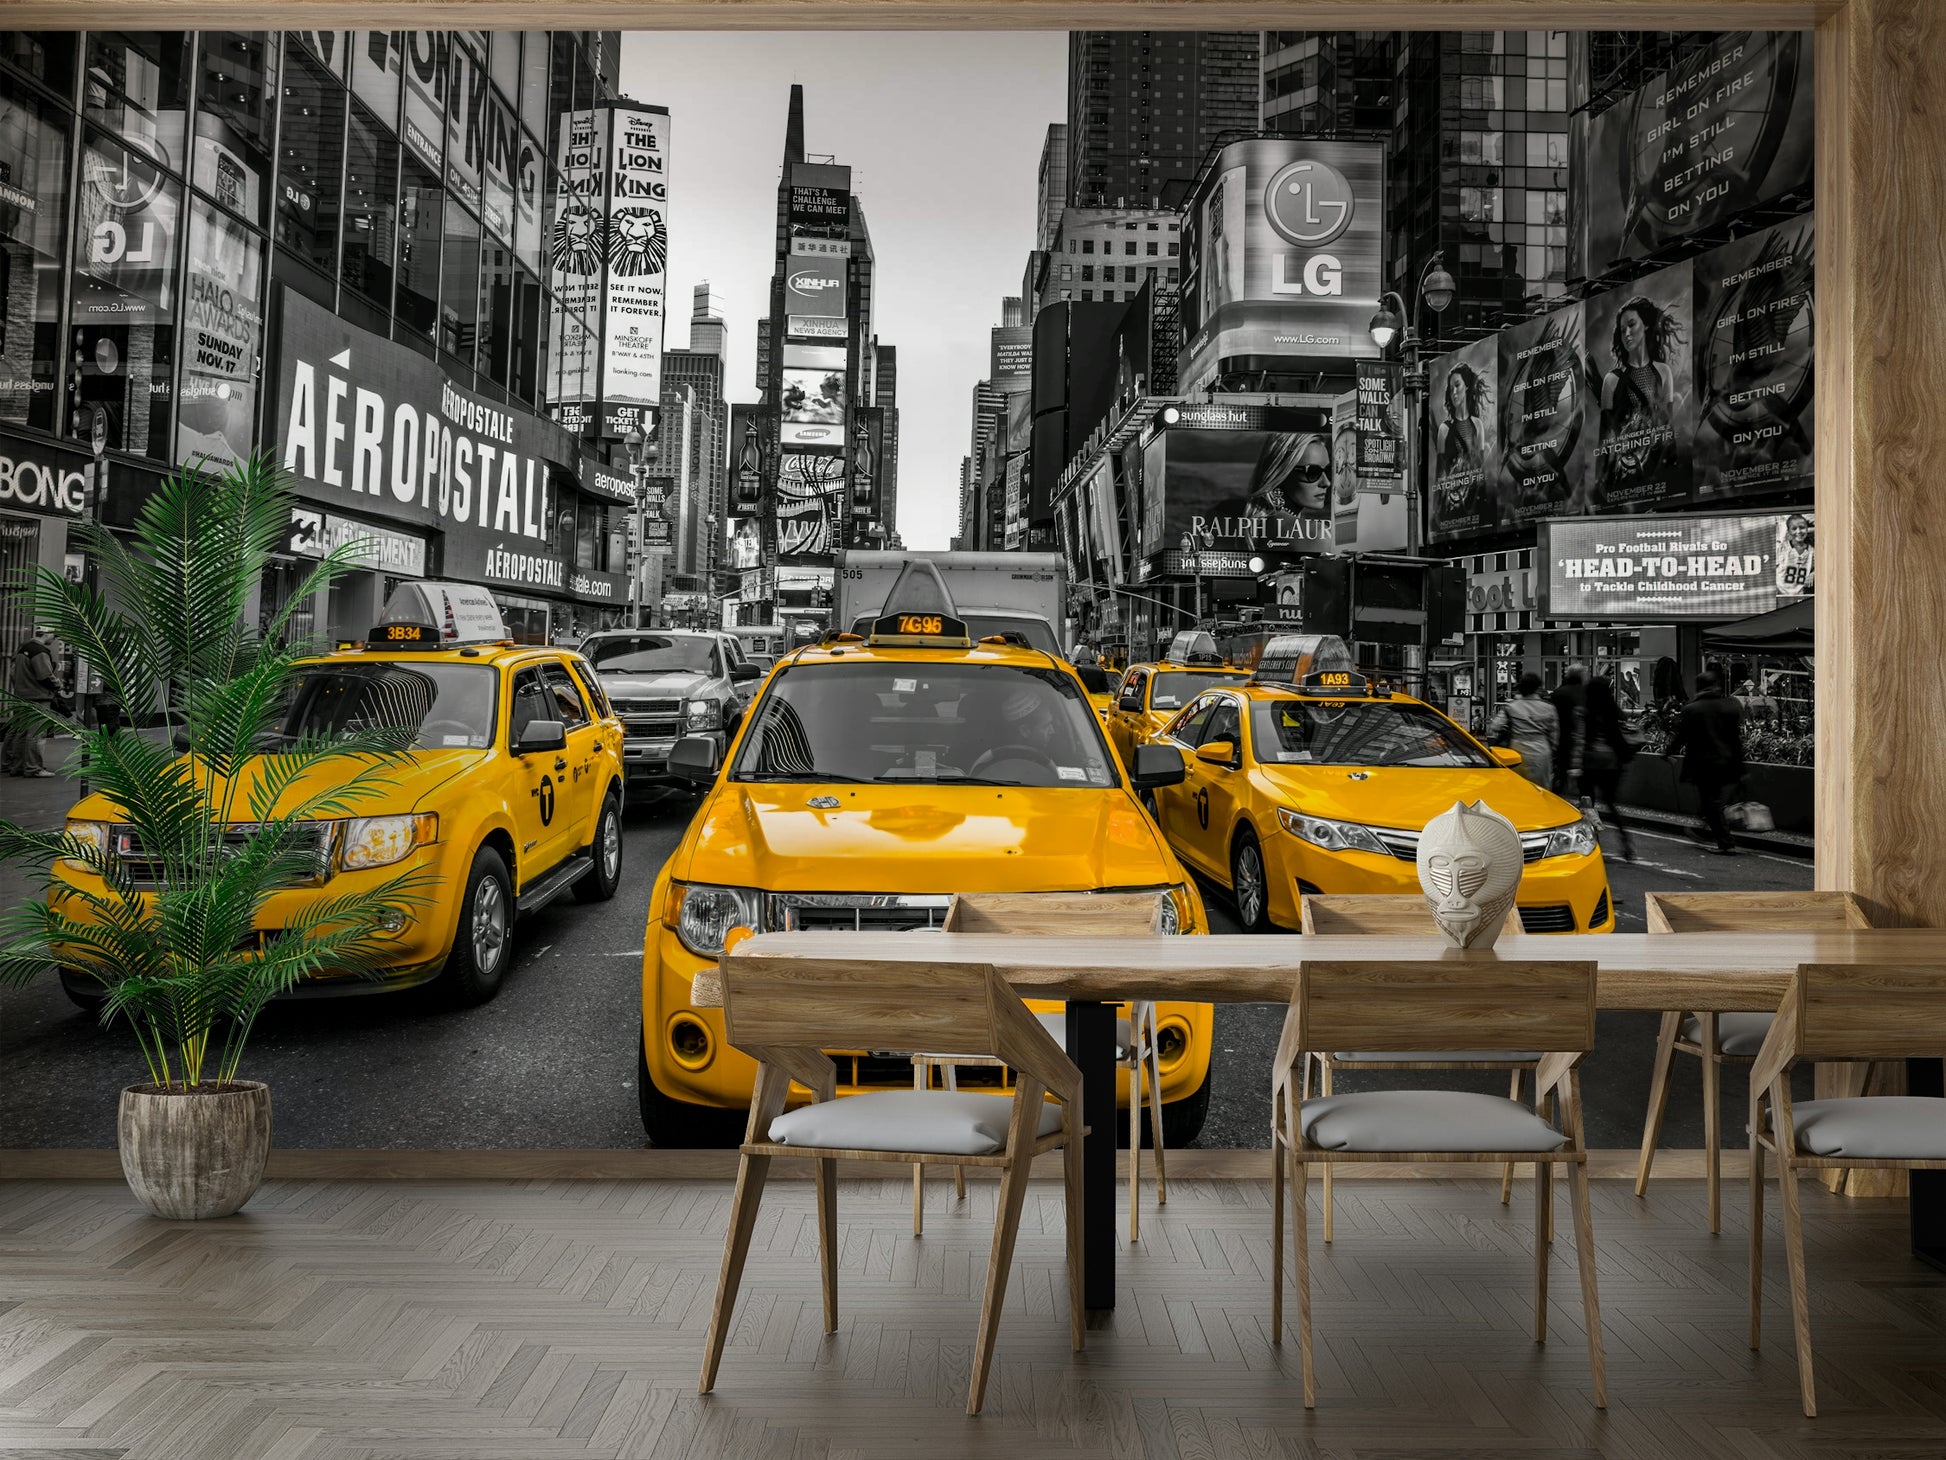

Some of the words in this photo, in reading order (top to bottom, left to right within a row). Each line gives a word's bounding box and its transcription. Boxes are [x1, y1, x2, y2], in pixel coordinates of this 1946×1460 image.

[1655, 45, 1743, 109] REMEMBER
[1647, 118, 1681, 143] GIRL
[1687, 97, 1710, 120] ON
[1716, 71, 1753, 103] FIRE
[627, 116, 653, 129] Disney
[407, 123, 441, 168] ENTRANCE
[624, 132, 656, 148] THE
[1663, 143, 1683, 163] I'M
[1689, 116, 1735, 149] STILL
[619, 148, 662, 170] LION
[450, 168, 461, 187] ON
[1664, 147, 1734, 192] BETTING
[614, 172, 666, 198] KING
[793, 187, 820, 196] THAT'S
[822, 189, 828, 197] A
[792, 196, 837, 206] CHALLENGE
[1668, 200, 1690, 220] ON
[1695, 180, 1729, 206] YOU
[792, 204, 805, 212] WE
[807, 205, 823, 213] CAN
[826, 206, 847, 215] MEET
[1272, 254, 1342, 296] LG
[1722, 254, 1793, 288] REMEMBER
[610, 284, 624, 292] SEE
[638, 287, 663, 295] NOW.
[795, 277, 840, 288] XINHUA
[191, 272, 234, 316] HALO
[612, 296, 658, 307] REMEMBER
[621, 307, 662, 317] FOREVER.
[1716, 313, 1744, 329] GIRL
[1746, 304, 1766, 319] ON
[1769, 295, 1799, 313] FIRE
[189, 301, 250, 344] AWARDS
[802, 319, 839, 329] XINHUA
[614, 335, 653, 344] MINSKOFF
[794, 327, 816, 335] NEWS
[816, 328, 847, 336] AGENCY
[198, 332, 243, 360] SUNDAY
[618, 341, 649, 350] THEATRE
[1274, 335, 1340, 345] www.LG.com
[1516, 338, 1563, 361] REMEMBER
[1729, 351, 1745, 364] I'M
[1748, 341, 1785, 359] STILL
[197, 349, 223, 370] NOV.
[225, 360, 236, 374] 17
[1359, 377, 1386, 391] SOME
[1513, 382, 1532, 393] GIRL
[1533, 377, 1546, 387] ON
[1548, 371, 1567, 384] FIRE
[1359, 392, 1390, 405] WALLS
[1729, 382, 1786, 405] BETTING
[442, 379, 513, 444] AÉROPOSTALE
[617, 407, 640, 418] GET
[1181, 410, 1227, 424] sunglass
[1229, 411, 1248, 422] hut
[1360, 405, 1378, 418] CAN
[1521, 412, 1533, 423] I'M
[1536, 406, 1558, 419] STILL
[1359, 418, 1381, 431] TALK
[1617, 430, 1644, 441] HUNGER
[1646, 424, 1672, 434] GAMES
[1732, 431, 1752, 444] ON
[1754, 424, 1783, 439] YOU
[691, 422, 700, 474] NOVOTEL
[1364, 439, 1395, 452] SPOTLIGHT
[1521, 439, 1558, 455] BETTING
[1593, 436, 1651, 457] CATCHING
[1364, 453, 1394, 464] BROADWAY
[1720, 462, 1780, 479] NOVEMBER
[1782, 459, 1797, 469] 22
[1431, 477, 1470, 492] CATCHING
[1523, 476, 1536, 487] ON
[1538, 472, 1555, 484] YOU
[646, 486, 664, 495] SOME
[1606, 484, 1654, 499] NOVEMBER
[1655, 481, 1666, 490] 22
[646, 495, 665, 503] WALLS
[1192, 516, 1267, 539] RALPH
[1277, 517, 1332, 540] LAUR
[1595, 544, 1615, 553] Pro
[1619, 542, 1666, 553] Football
[1669, 541, 1708, 552] Rivals
[1712, 541, 1728, 551] Go
[485, 543, 563, 587] AÉROPOSTALE
[1201, 558, 1246, 571] sunglass
[842, 569, 863, 580] 505
[1784, 565, 1807, 585] 88
[1580, 582, 1591, 592] to
[1594, 581, 1634, 592] Tackle
[1638, 580, 1698, 591] Childhood
[1701, 581, 1746, 591] Cancer
[387, 626, 421, 640] 3B34
[899, 616, 943, 634] 7G95
[1320, 672, 1350, 685] 1A93
